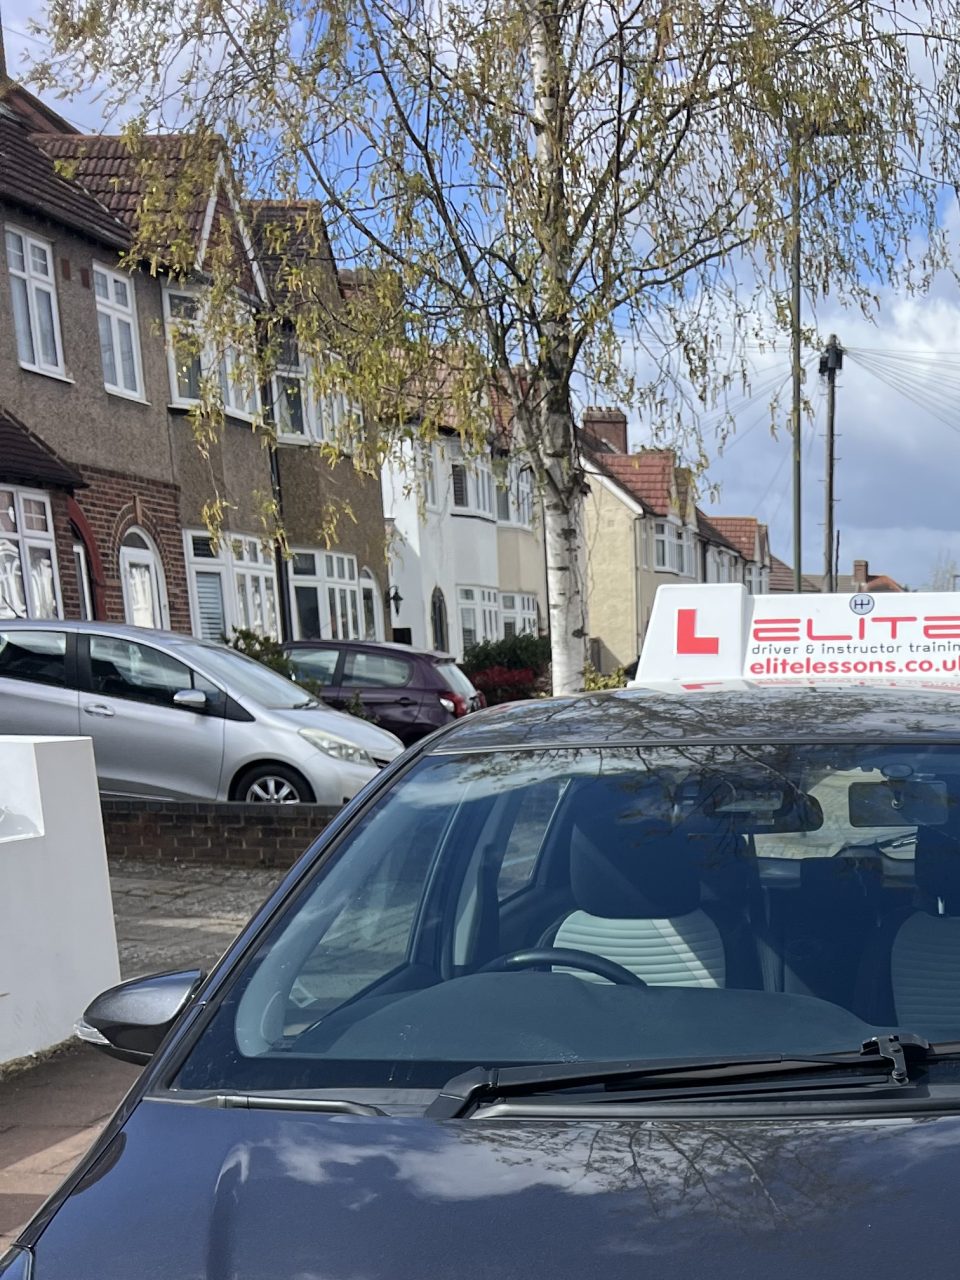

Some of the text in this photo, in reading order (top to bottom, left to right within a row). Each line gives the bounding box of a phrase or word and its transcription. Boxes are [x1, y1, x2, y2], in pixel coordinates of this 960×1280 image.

[677, 609, 719, 655] L
[752, 643, 799, 655] driver
[805, 643, 814, 655] &
[821, 642, 902, 655] instructor
